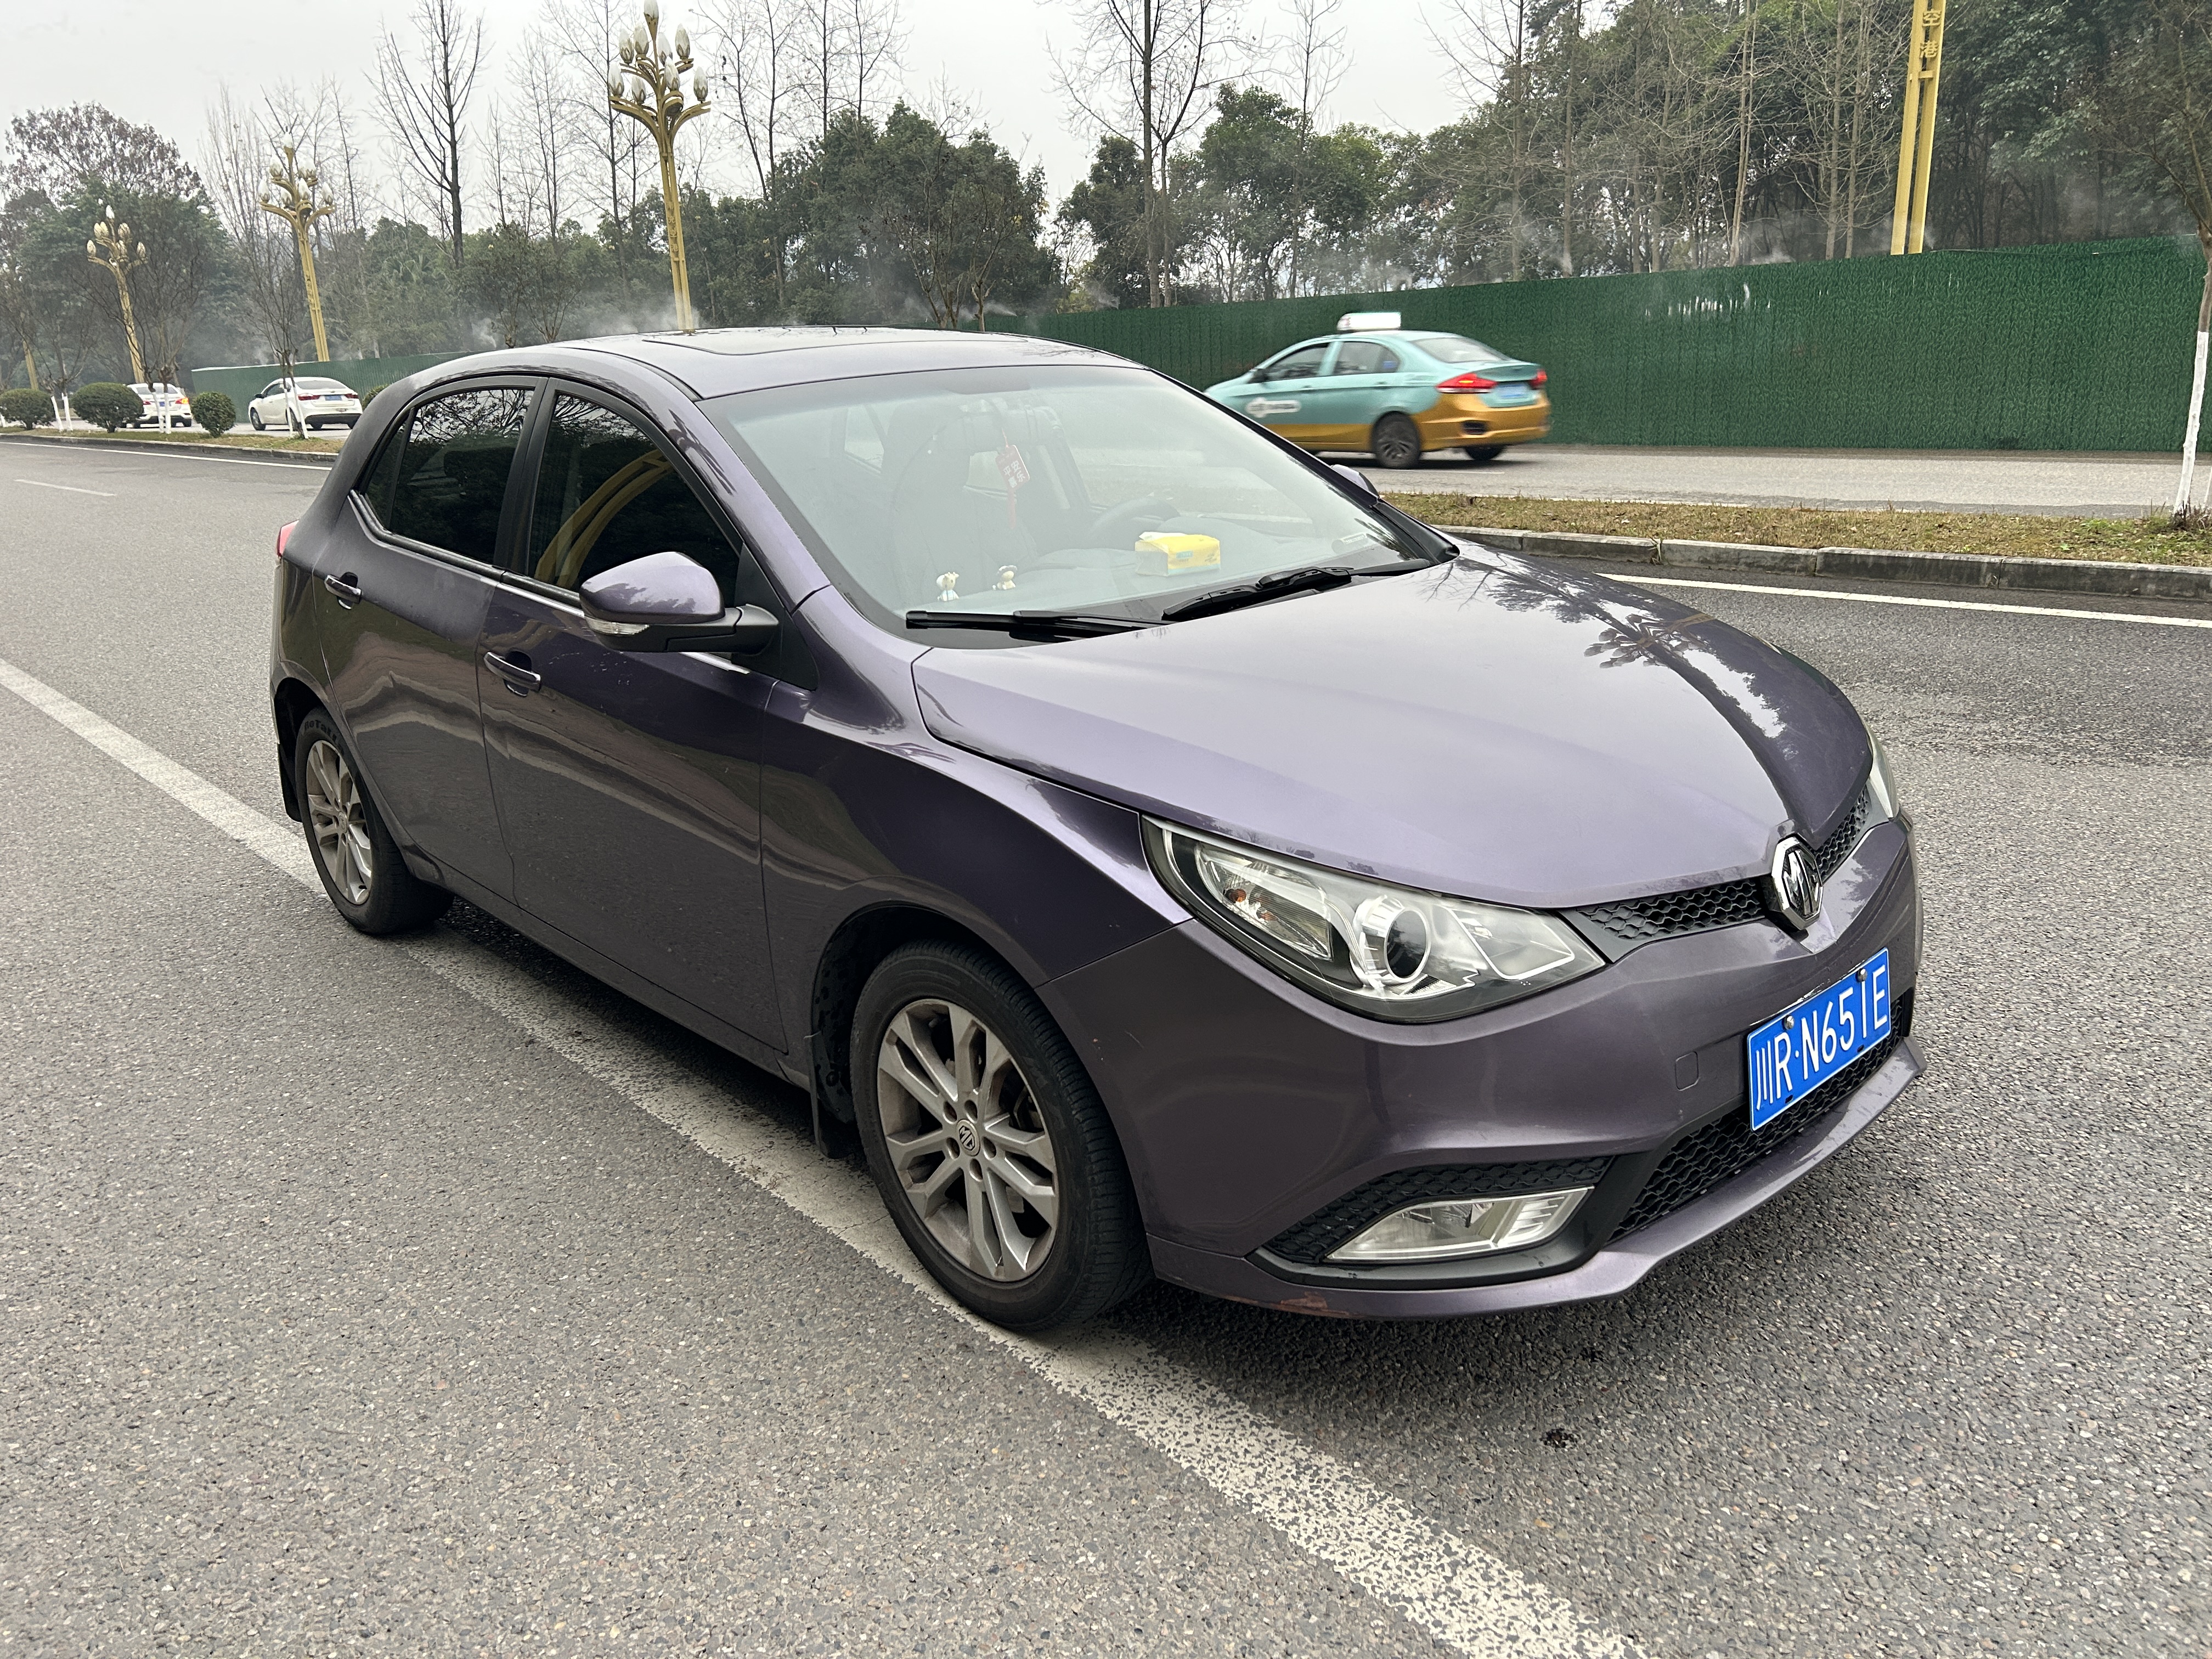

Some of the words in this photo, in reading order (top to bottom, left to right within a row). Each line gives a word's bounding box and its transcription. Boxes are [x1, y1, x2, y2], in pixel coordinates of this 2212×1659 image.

[1920, 8, 1942, 58] 空港
[1003, 460, 1021, 476] 平安
[960, 1126, 975, 1150] MG
